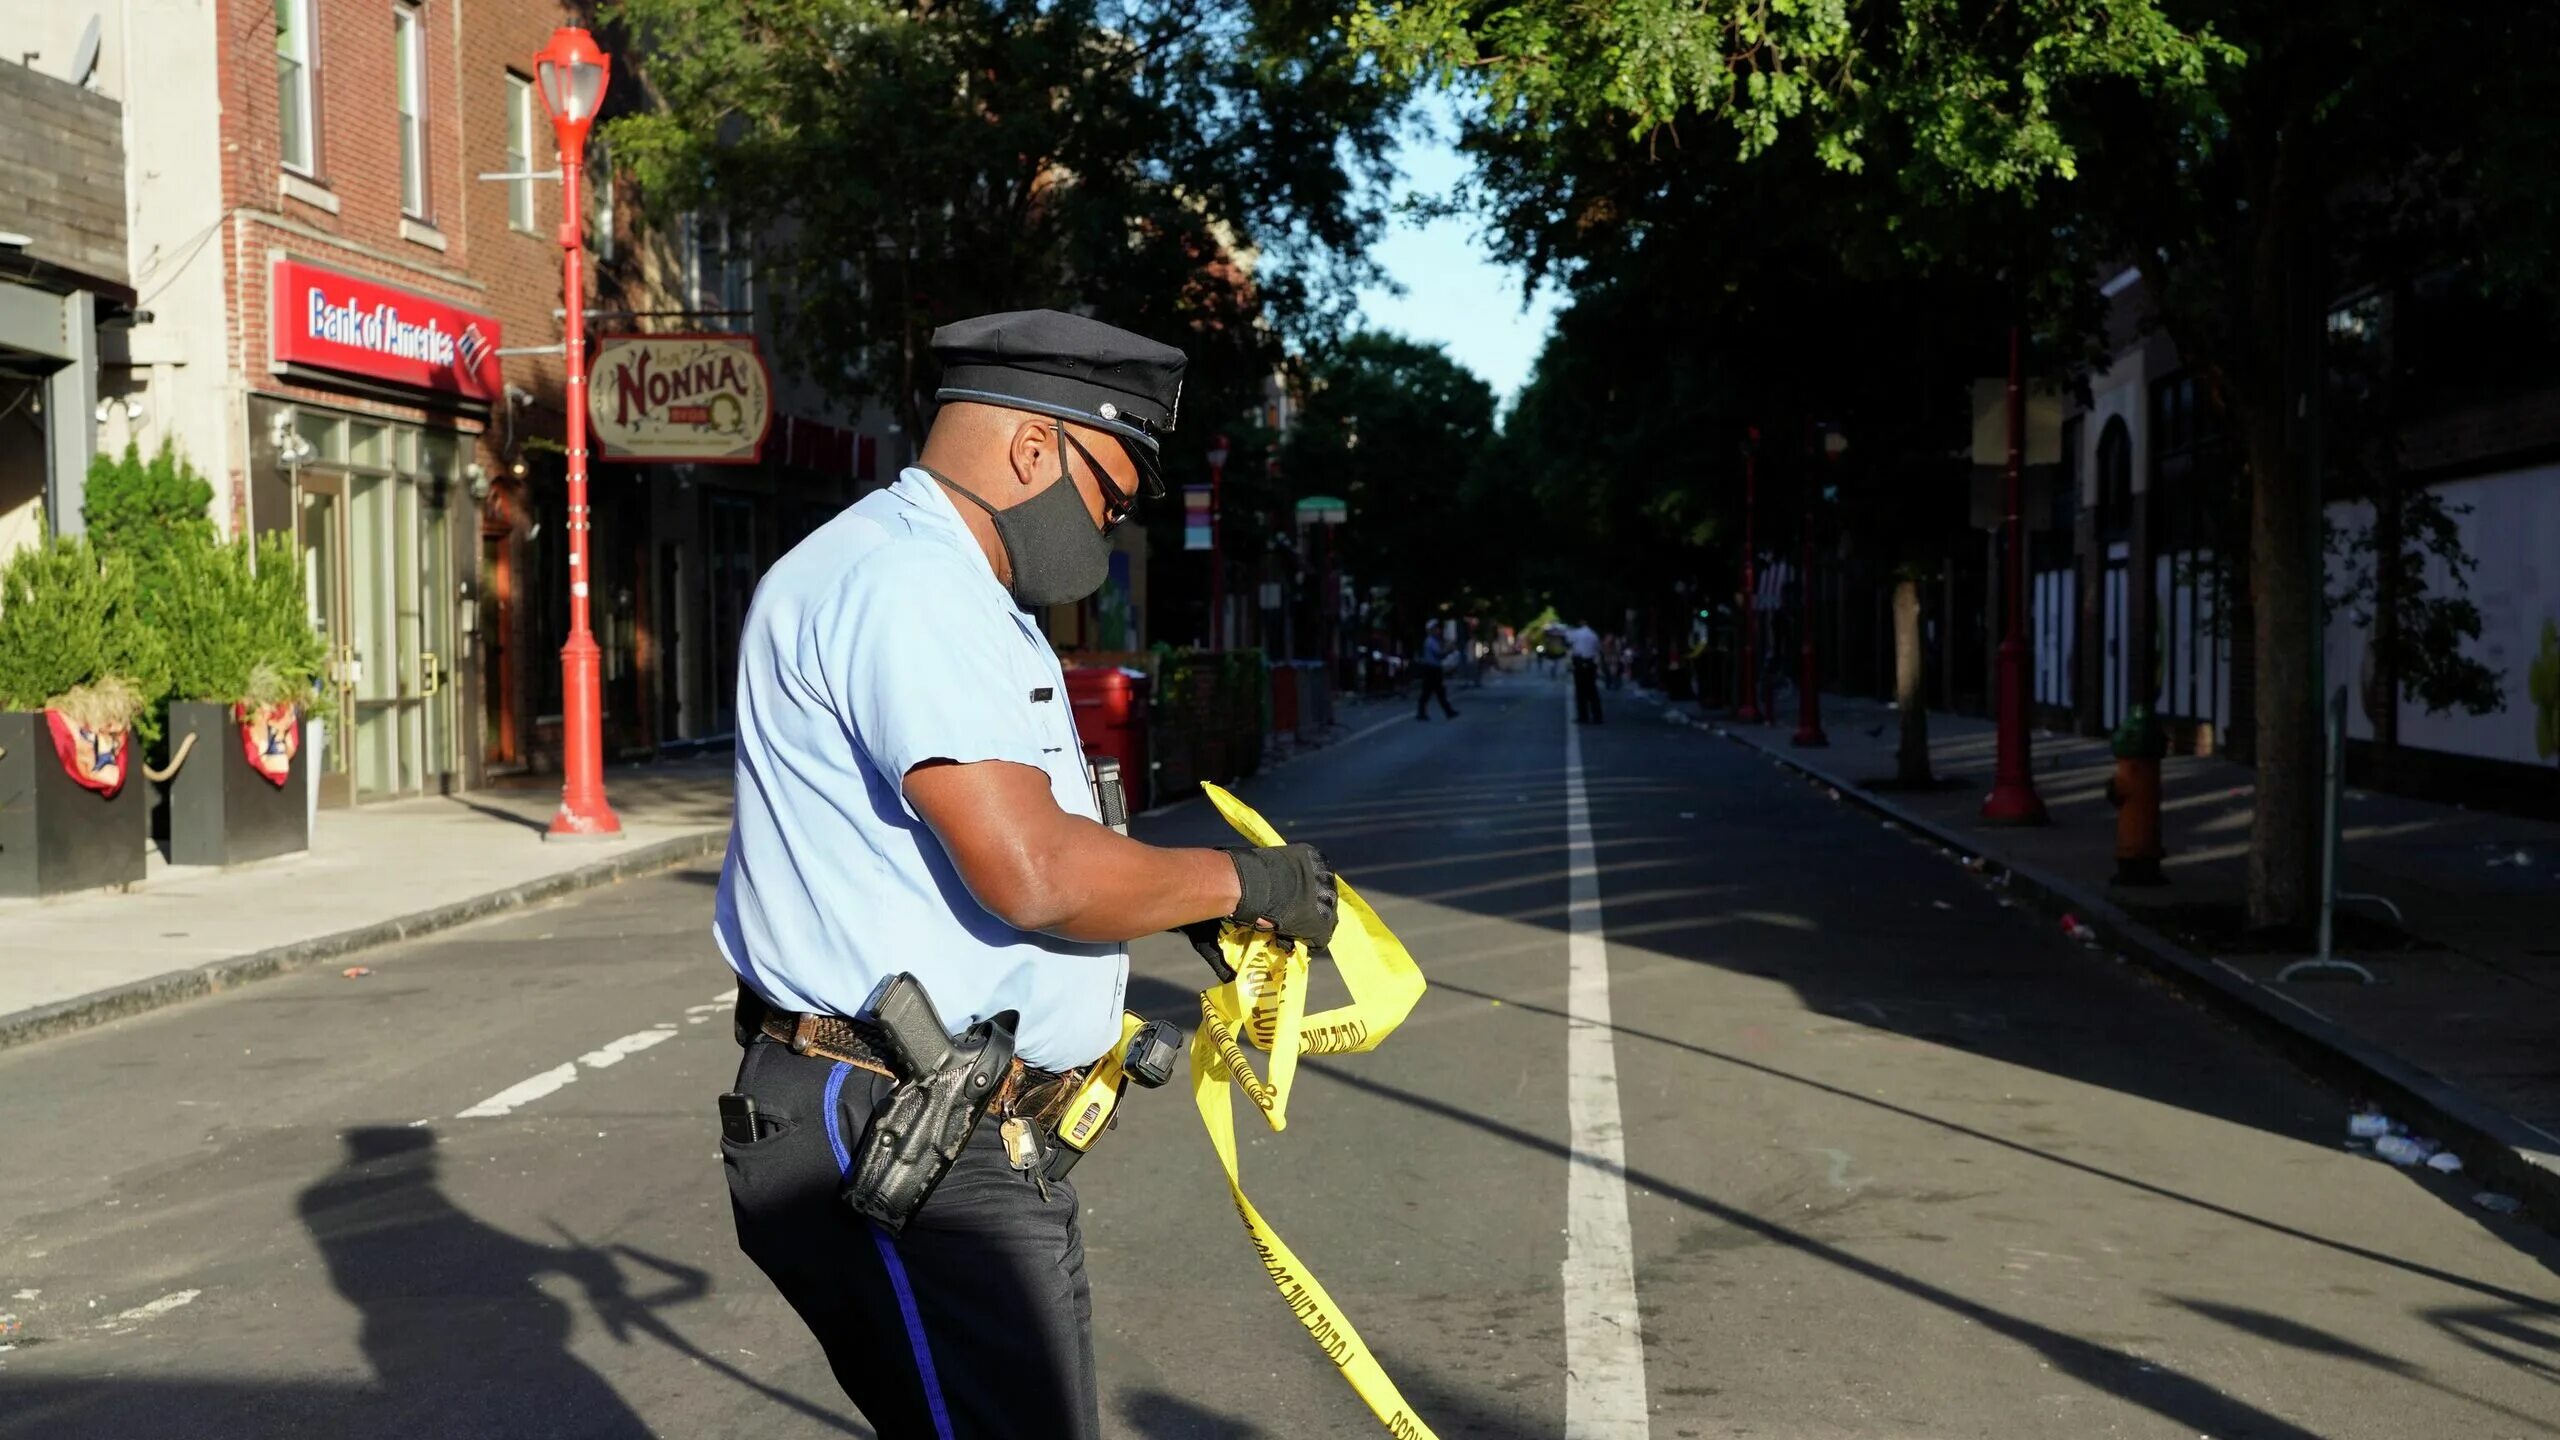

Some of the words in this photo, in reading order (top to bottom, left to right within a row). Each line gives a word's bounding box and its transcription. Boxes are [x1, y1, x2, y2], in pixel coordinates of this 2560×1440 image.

[308, 286, 363, 348] Bank
[362, 303, 386, 352] of
[384, 306, 455, 368] America
[615, 345, 749, 428] NONNA
